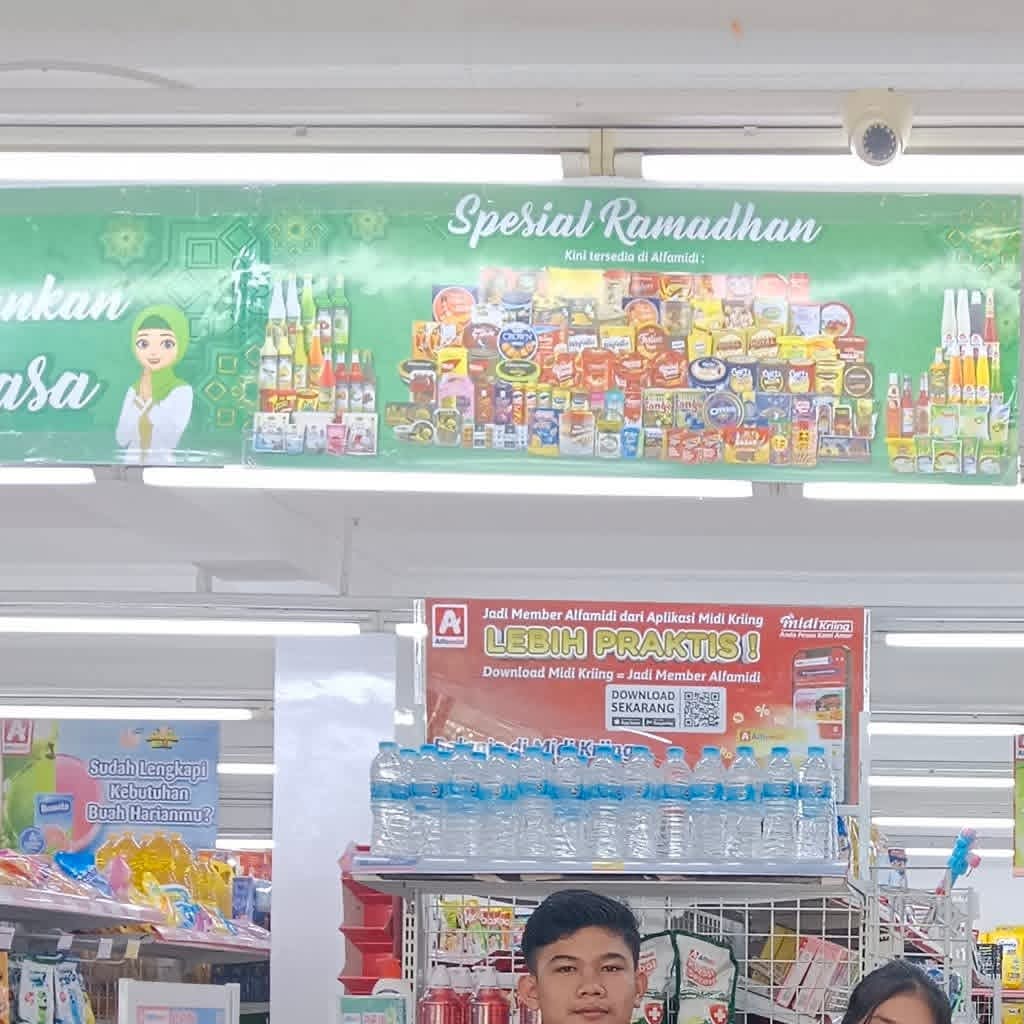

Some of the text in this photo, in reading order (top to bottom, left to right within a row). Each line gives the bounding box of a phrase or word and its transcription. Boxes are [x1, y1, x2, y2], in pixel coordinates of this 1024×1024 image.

[446, 194, 822, 248] Spesial Ramadhan
[565, 250, 588, 263] Kini
[590, 251, 634, 263] tersedia
[637, 251, 649, 263] di
[651, 252, 699, 264] Alfamidi
[482, 607, 764, 628] Jadi Member Alfamidi dari Aplikasi Midi Kriing
[485, 626, 587, 657] LEBIH
[595, 629, 740, 661] PRAKTIS
[483, 666, 545, 679] Download
[548, 667, 576, 679] Midi
[578, 668, 614, 682] Kriing
[626, 669, 652, 681] Jadi
[655, 670, 706, 682] Member
[709, 671, 761, 683] Alfamidi
[611, 689, 676, 701] DOWNLOAD
[611, 702, 676, 714] SEKARANG
[89, 759, 208, 781] Sudah Lengkapi
[110, 783, 190, 800] Kebutuhan
[88, 804, 126, 820] Buah
[130, 805, 214, 822] Harianmu?
